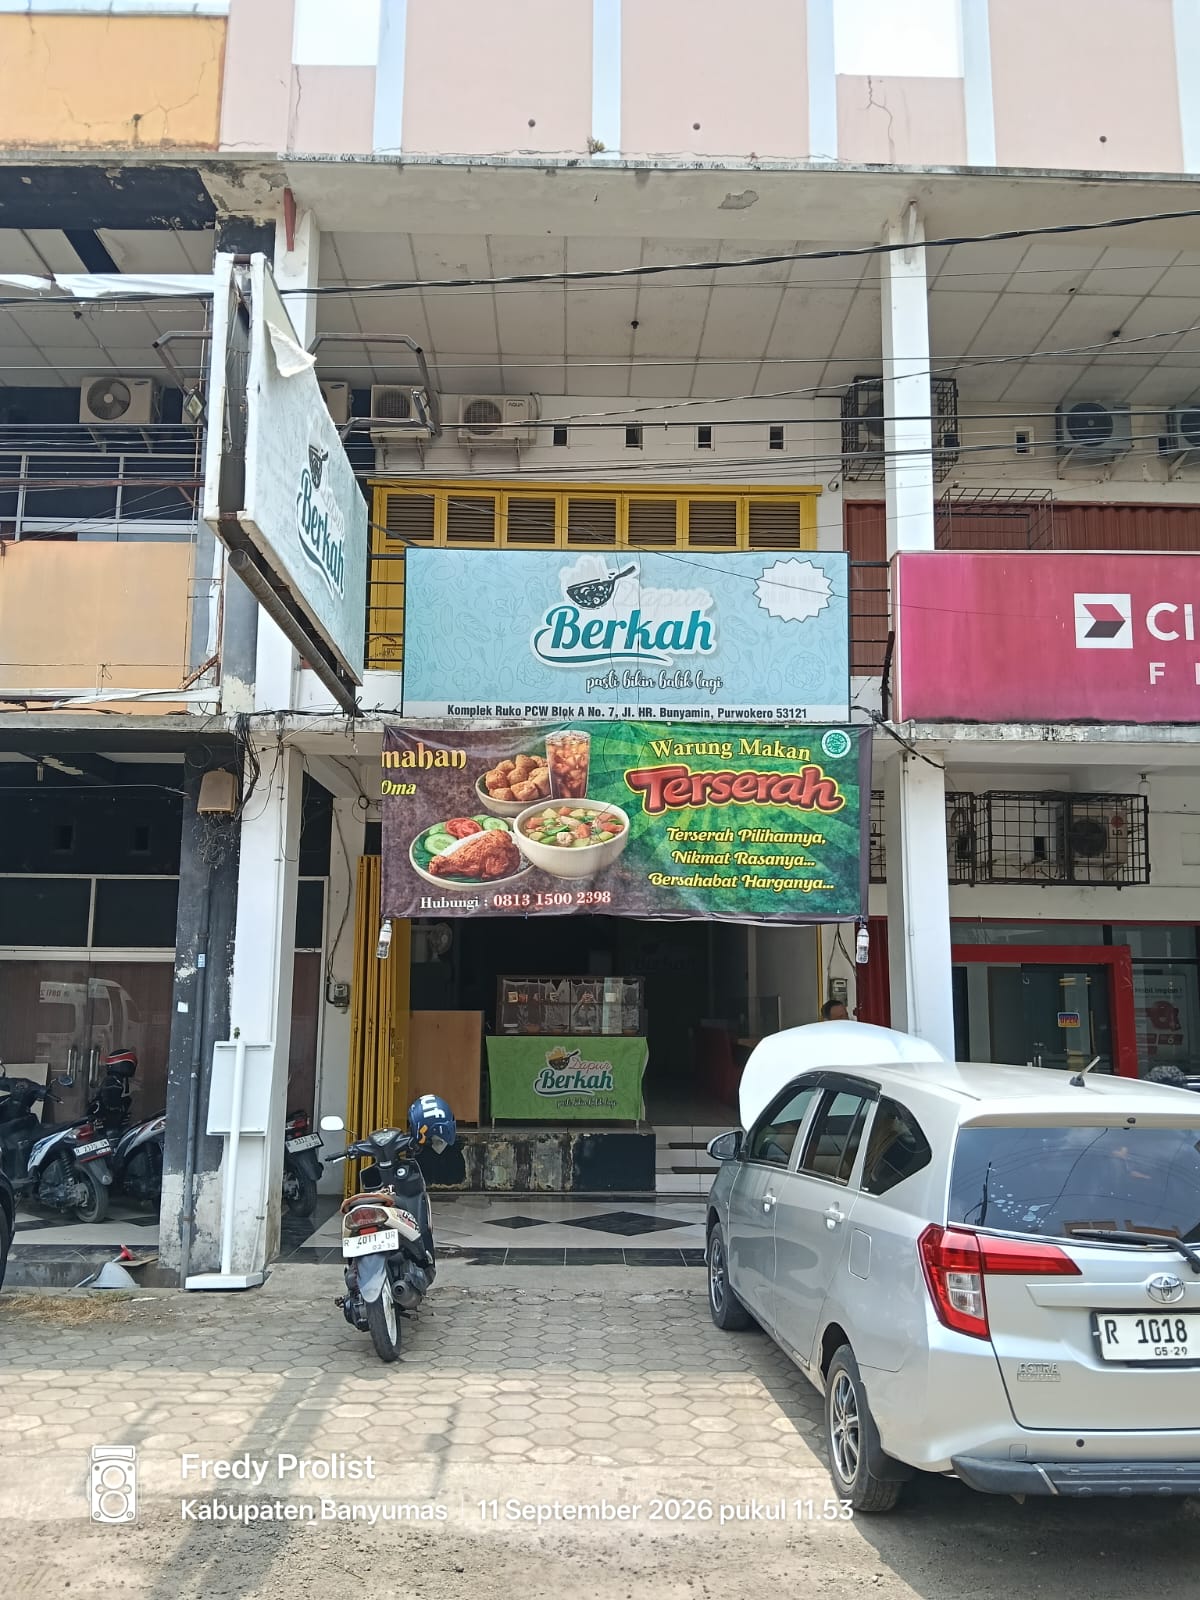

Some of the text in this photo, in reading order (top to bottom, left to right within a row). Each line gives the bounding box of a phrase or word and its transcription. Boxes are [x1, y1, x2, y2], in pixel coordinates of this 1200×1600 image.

[301, 468, 344, 594] Berkah
[541, 605, 713, 655] Berkah
[586, 668, 723, 695] pasti bikin balik lagi
[447, 704, 807, 720] Komplek Ruko PCW Blok A No. 7, Jl. HR. Bunyamin, Purwokero 53121
[649, 738, 733, 759] Warung
[738, 738, 811, 762] Makan
[624, 764, 845, 814] Terserah
[667, 827, 826, 846] Terserah Pilihannya,
[671, 850, 816, 869] Nikmat Rasanya...
[648, 872, 835, 893] Bersahabat Harganya...
[420, 896, 479, 911] Hubungi
[493, 892, 530, 907] 0813
[535, 892, 573, 906] 1500
[576, 891, 612, 905] 2398
[537, 1068, 612, 1091] Berkah
[1104, 1318, 1188, 1345] R 1018
